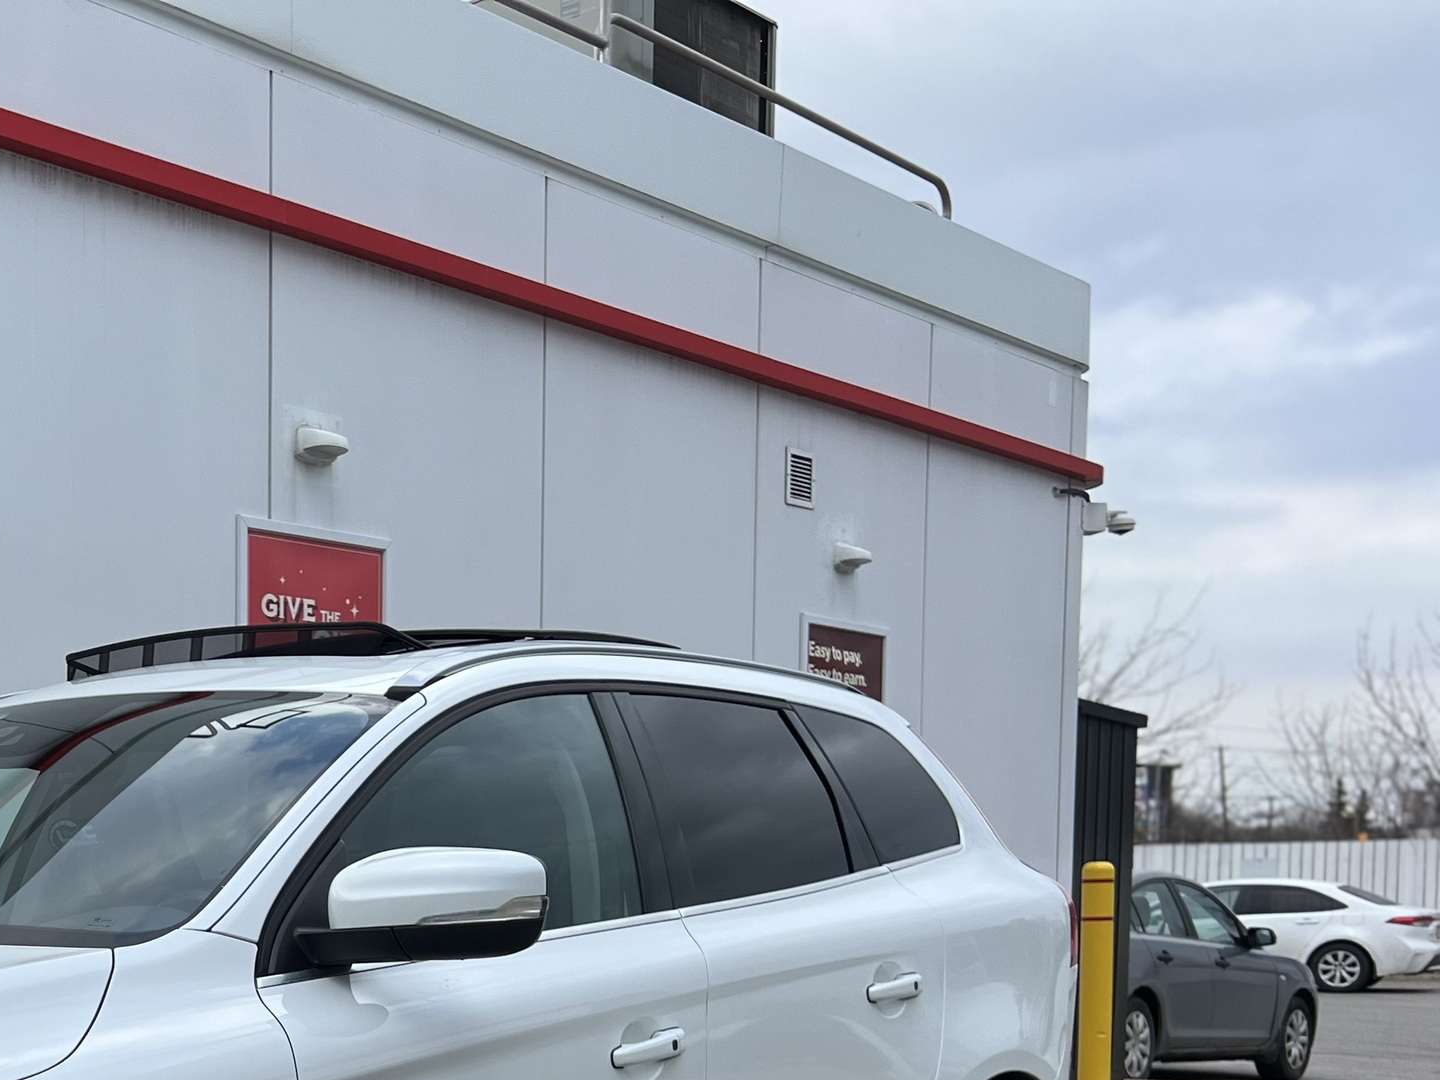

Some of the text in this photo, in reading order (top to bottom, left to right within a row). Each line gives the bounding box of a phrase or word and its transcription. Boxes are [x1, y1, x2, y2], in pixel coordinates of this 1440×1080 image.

[260, 593, 341, 622] GIVE THE
[809, 640, 863, 667] Easy to pay.
